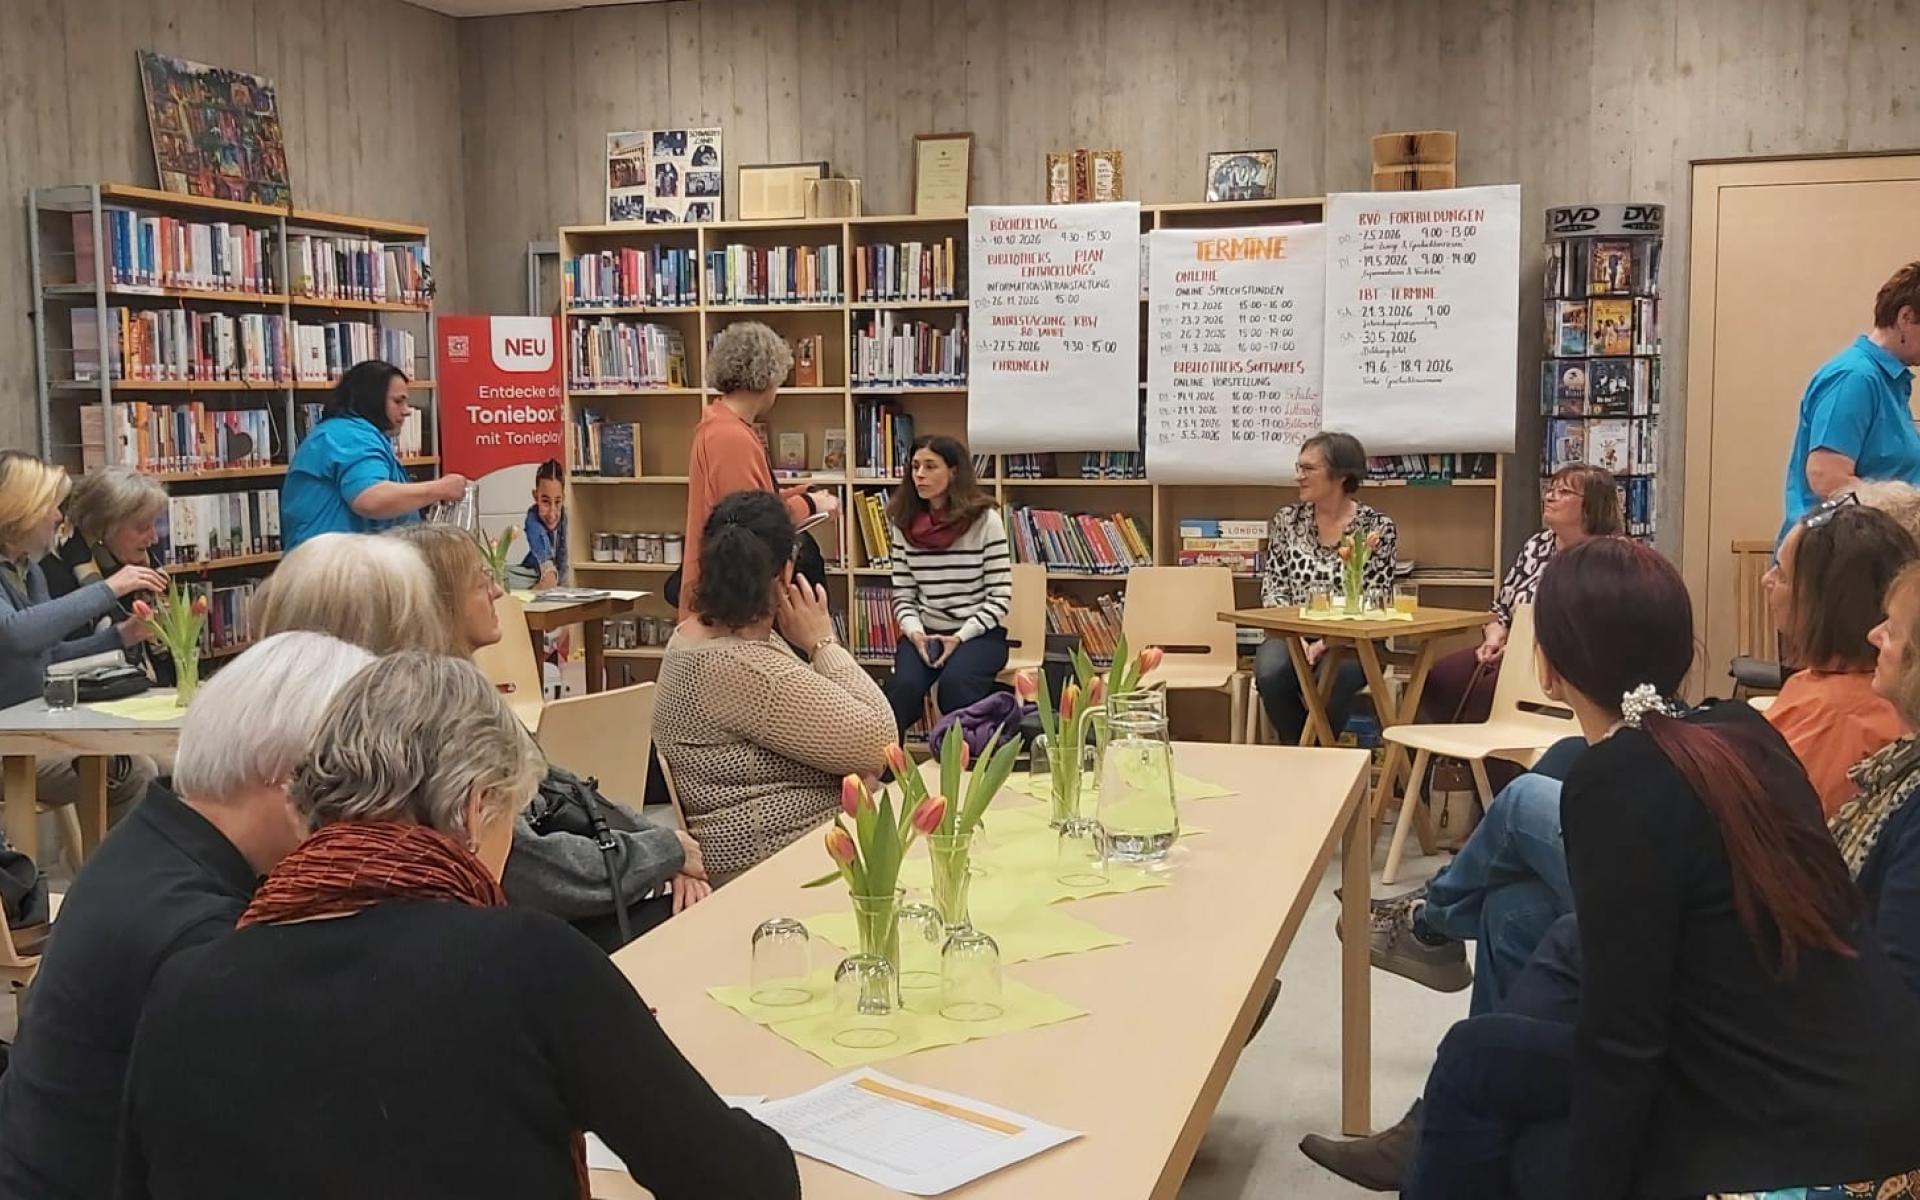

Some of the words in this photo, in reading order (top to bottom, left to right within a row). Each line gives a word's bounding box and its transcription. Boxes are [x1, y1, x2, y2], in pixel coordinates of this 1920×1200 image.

[1390, 209, 1484, 225] FORTBILDUNGEN
[1554, 208, 1600, 224] DVD
[1193, 236, 1289, 261] TERMINE
[505, 338, 546, 357] NEU
[479, 385, 546, 399] Entdecke
[466, 404, 556, 424] Toniebox
[476, 432, 501, 445] mit
[1228, 527, 1264, 535] LONDON
